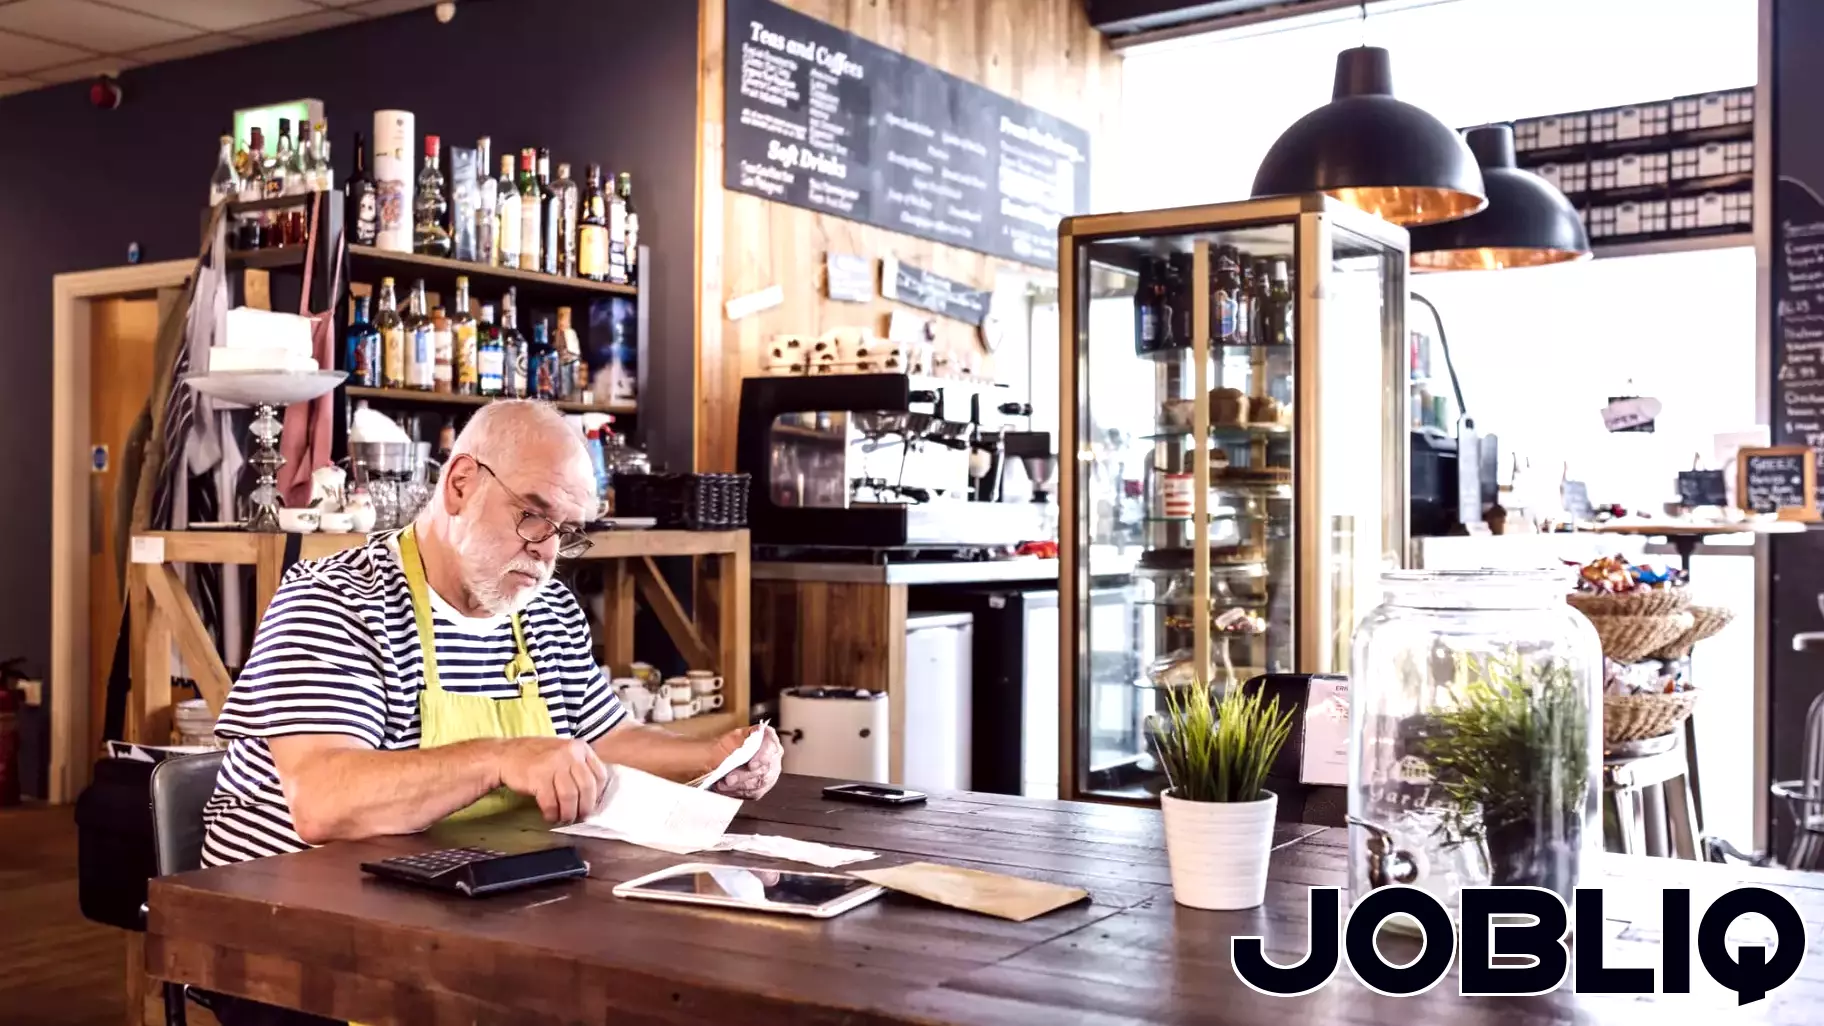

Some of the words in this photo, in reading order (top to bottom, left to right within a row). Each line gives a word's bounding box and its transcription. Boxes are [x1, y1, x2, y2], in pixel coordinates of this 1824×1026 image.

[750, 20, 786, 51] Teas
[786, 39, 816, 62] and
[816, 46, 864, 80] Coffees
[767, 139, 799, 168] Soft
[799, 148, 847, 179] Drinks
